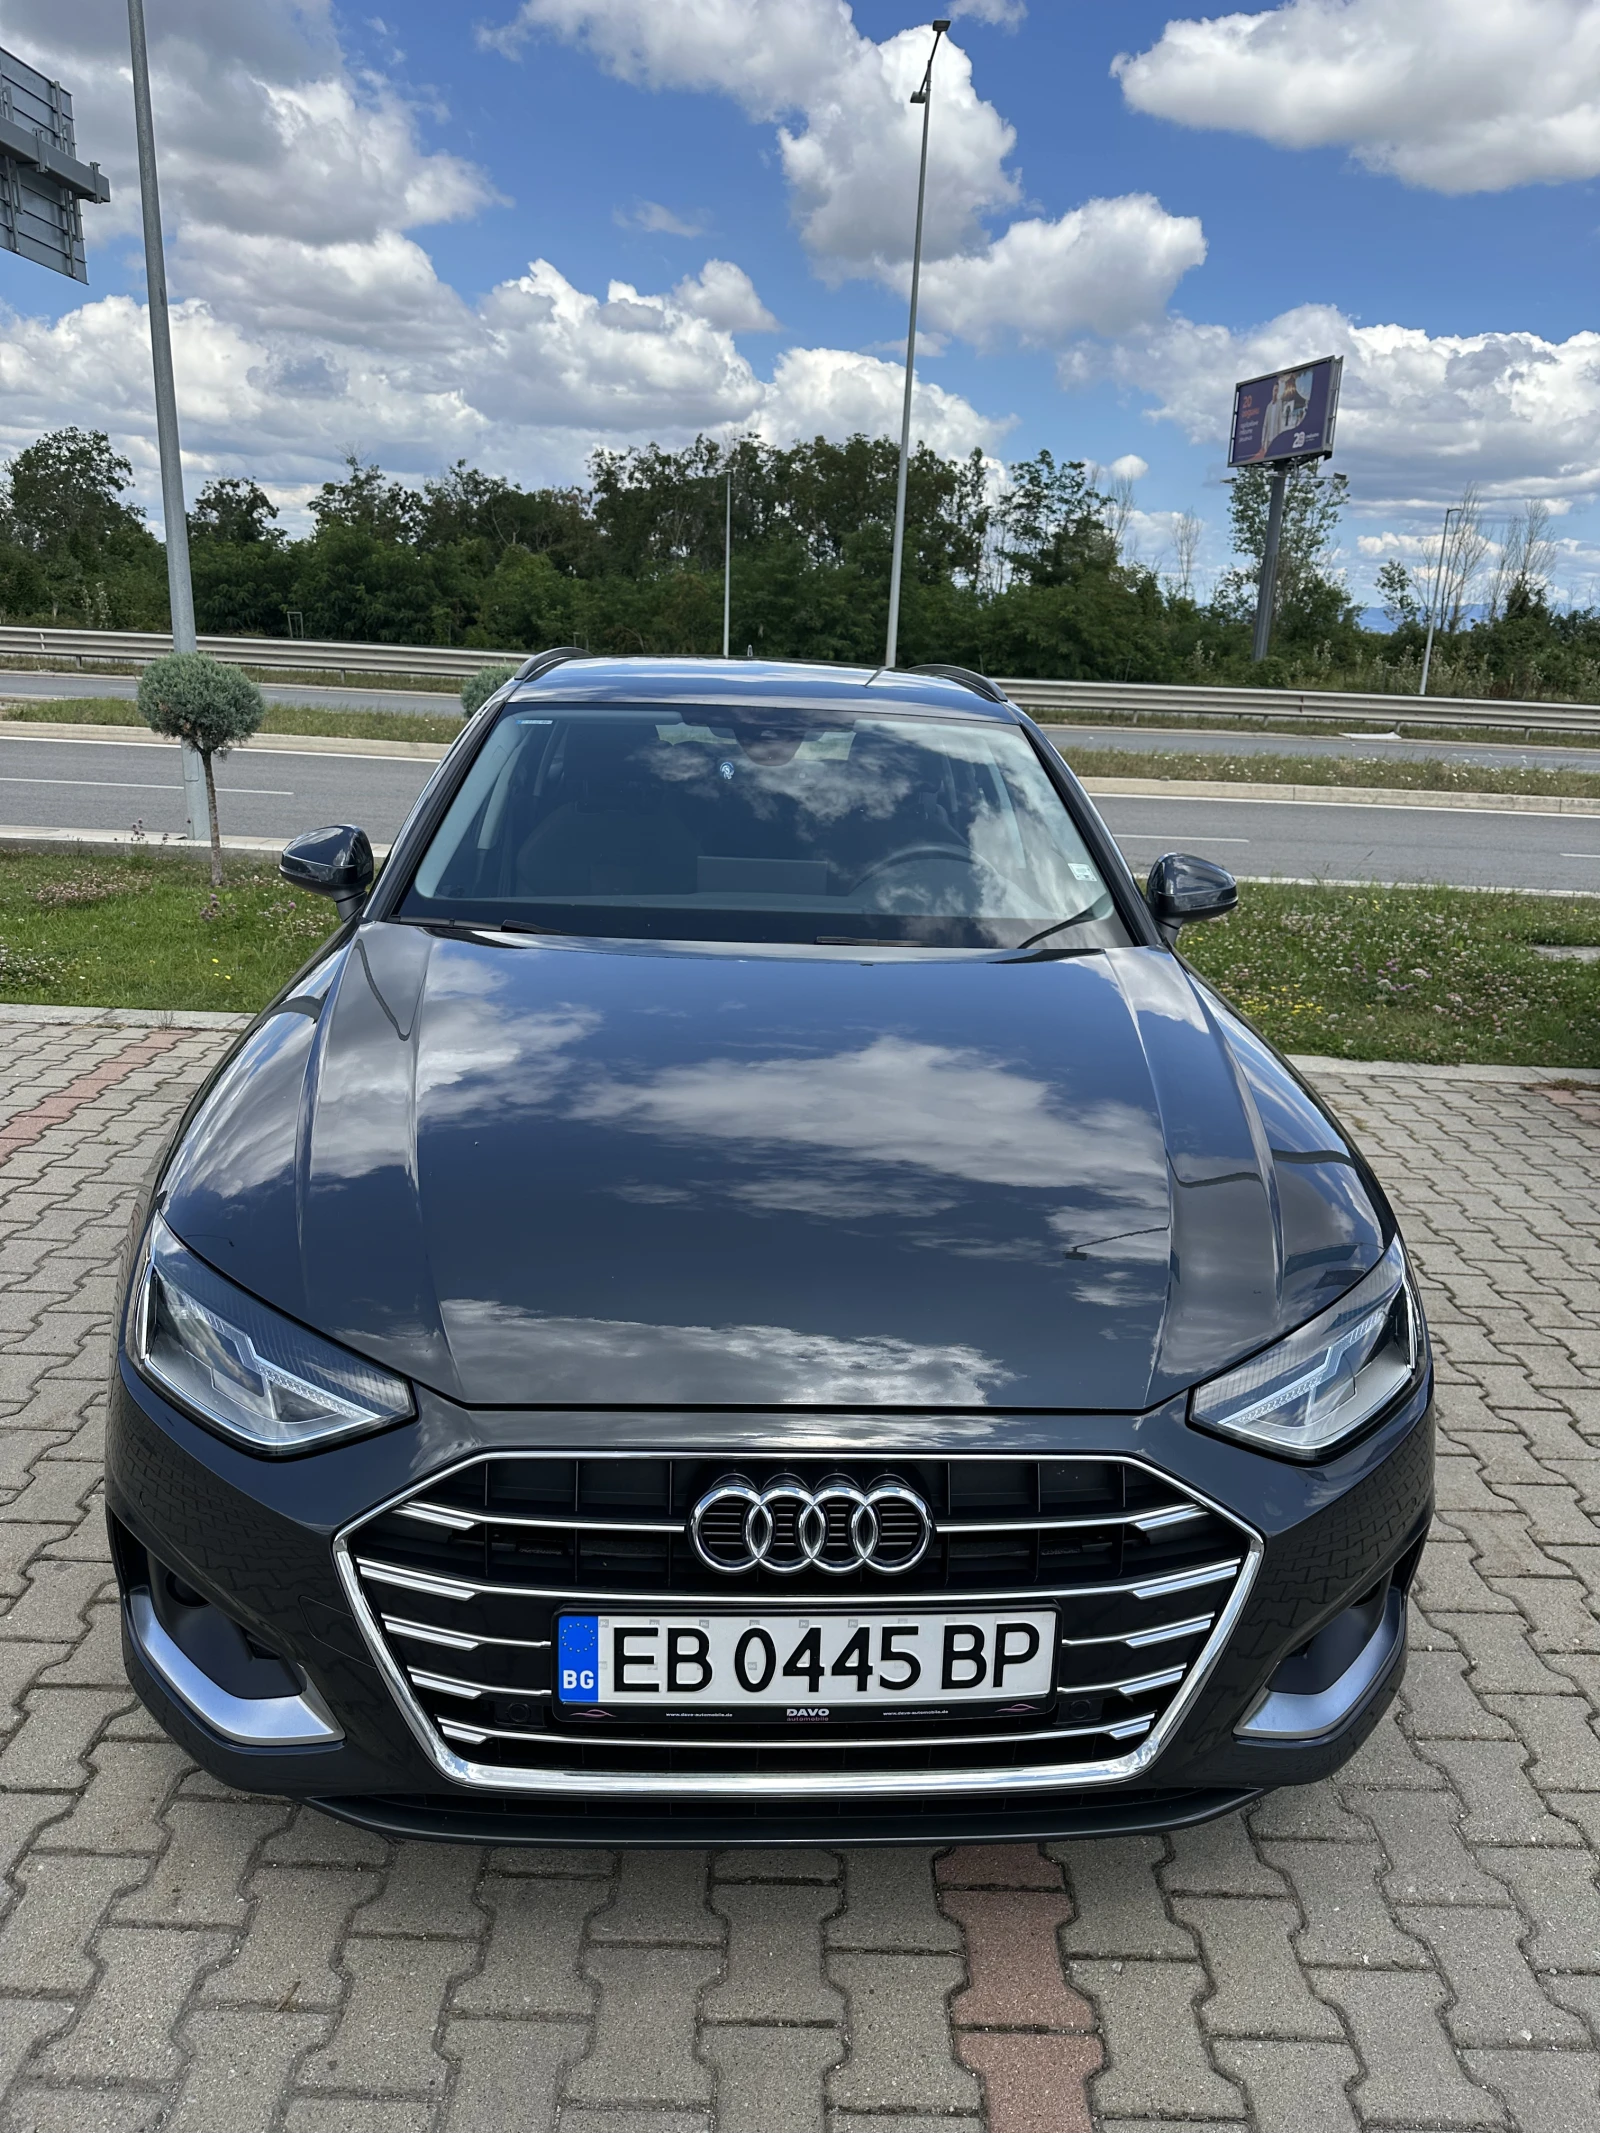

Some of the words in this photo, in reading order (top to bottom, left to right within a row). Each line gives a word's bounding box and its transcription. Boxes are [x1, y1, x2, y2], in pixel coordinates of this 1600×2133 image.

[614, 1627, 713, 1692] EB
[734, 1626, 921, 1692] 0445
[941, 1622, 1040, 1690] BP
[563, 1669, 594, 1689] BG
[786, 1708, 830, 1717] DAVO
